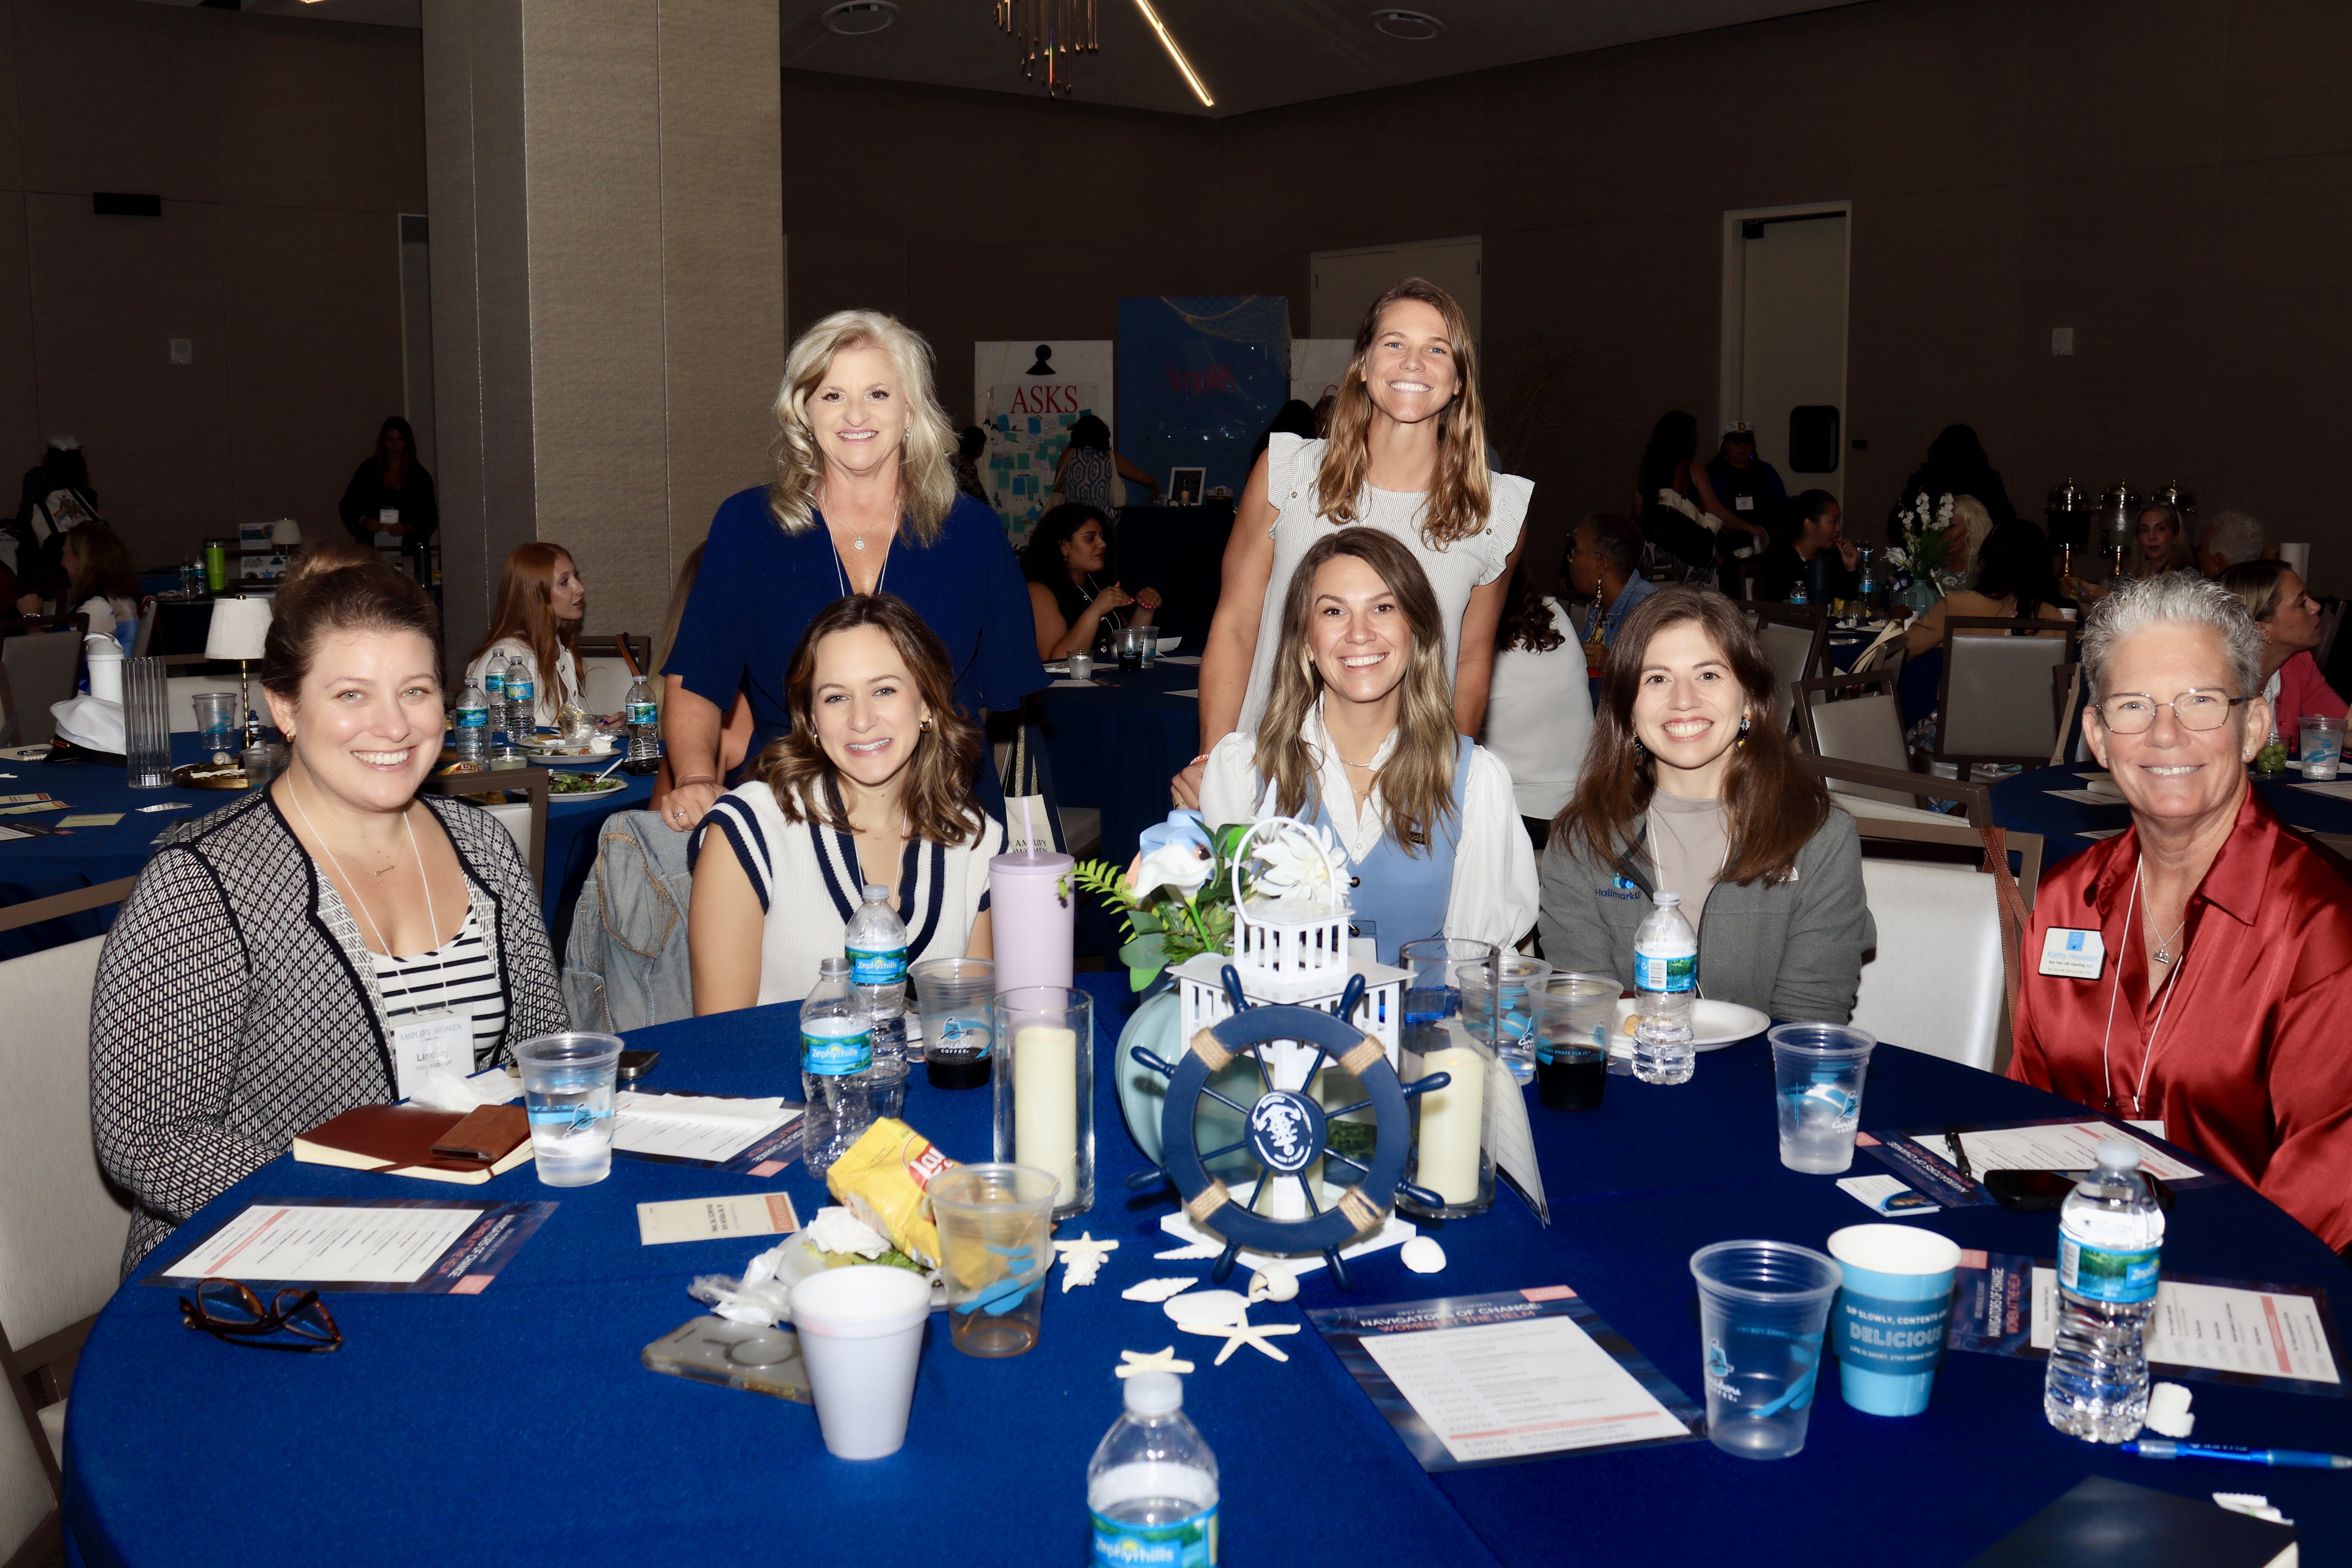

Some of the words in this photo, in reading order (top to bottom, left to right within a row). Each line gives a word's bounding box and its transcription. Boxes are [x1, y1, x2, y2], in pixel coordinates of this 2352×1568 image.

[1009, 385, 1078, 414] ASKS
[2047, 951, 2067, 960] Kathy
[2068, 953, 2098, 962] Houston
[857, 961, 897, 971] Zephyrhills
[399, 1028, 432, 1042] AMPLIFY
[434, 1023, 462, 1034] WOMEN
[417, 1048, 450, 1062] Lindsey
[811, 1047, 858, 1059] Zephyrhills
[769, 1197, 786, 1220] PERMISSION
[718, 1213, 727, 1223] PERSON
[777, 1220, 789, 1230] SLIP
[478, 1214, 515, 1247] NAVIGATORS
[471, 1246, 483, 1255] OF
[1990, 1290, 2003, 1300] OF
[1359, 1312, 1455, 1328] NAVIGATORS
[1456, 1308, 1475, 1318] OF
[1478, 1302, 1543, 1315] CHANGE:
[1464, 1314, 1493, 1324] THE
[1494, 1310, 1536, 1321] HELM
[1858, 1310, 1895, 1325] SLOWLY,
[1896, 1312, 1938, 1325] CONTENTS
[1987, 1299, 2002, 1337] NAVIGATORS
[1849, 1321, 1943, 1348] DELICIOUS
[1096, 1535, 1174, 1564] Zephyrhills
